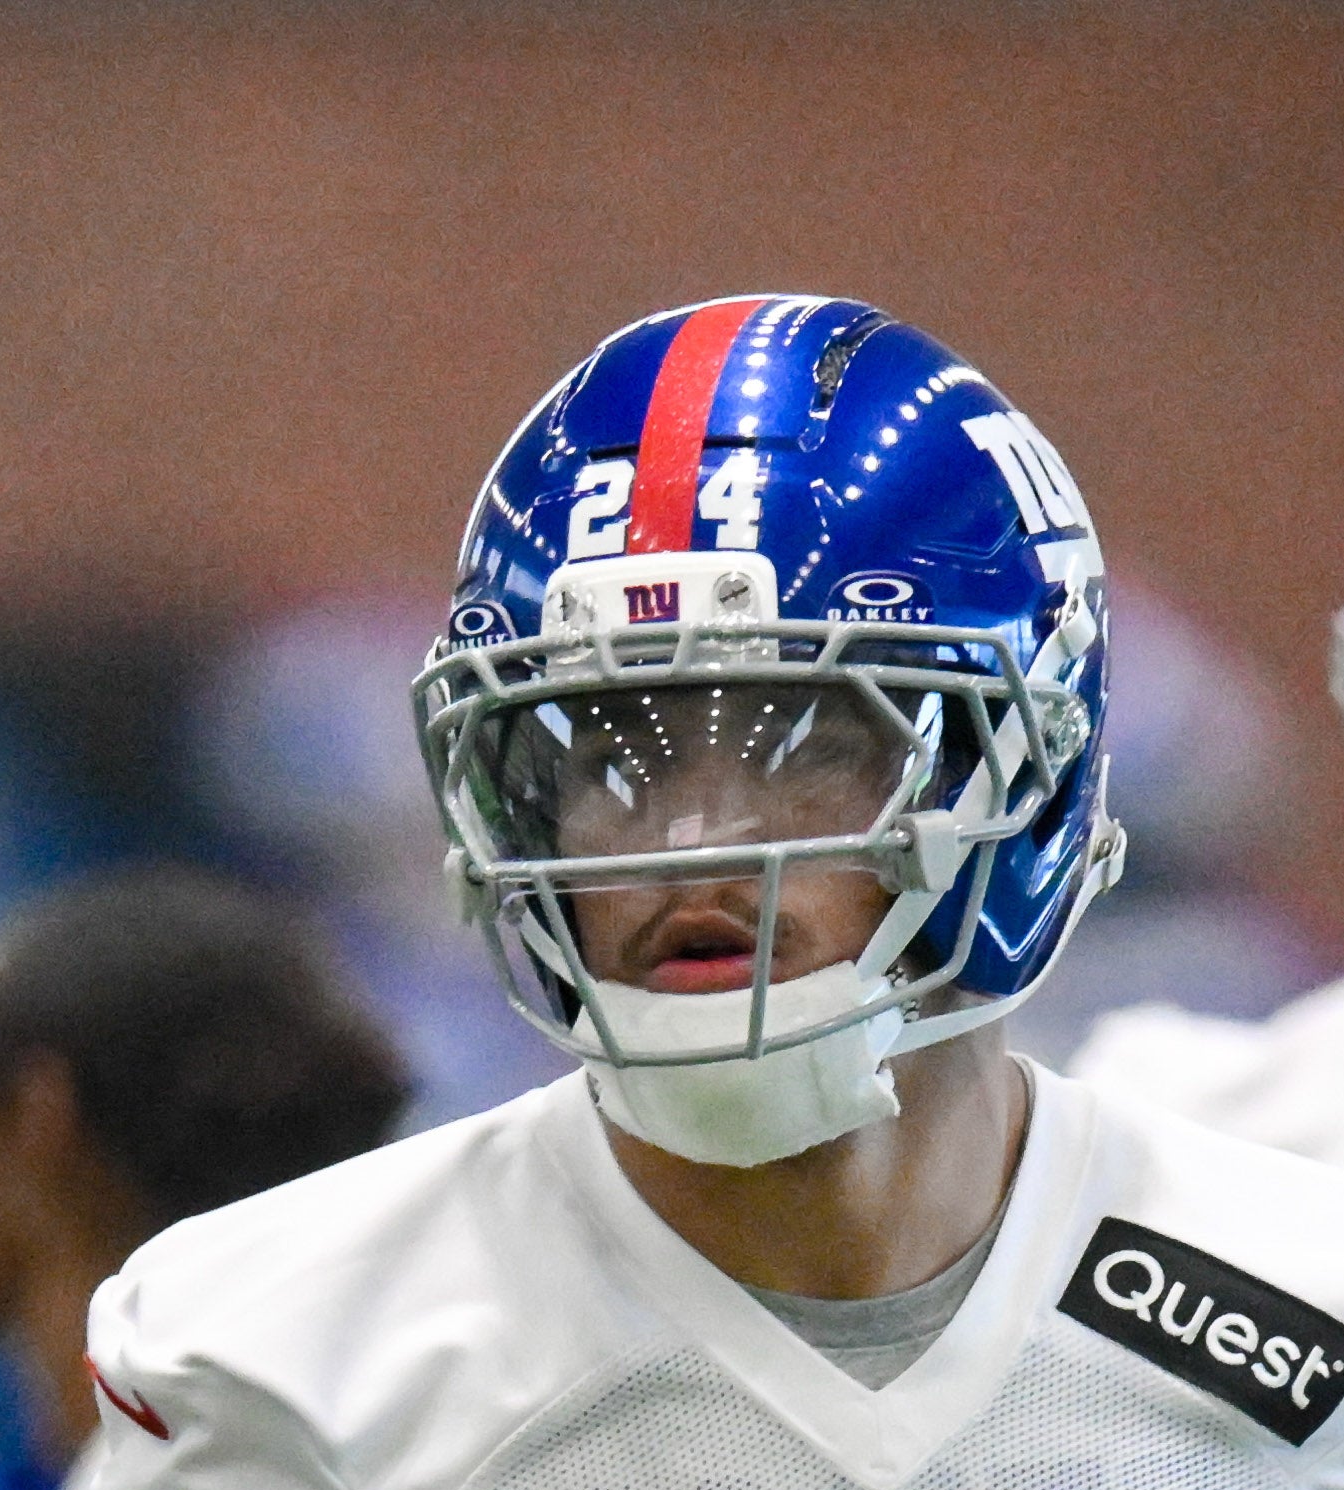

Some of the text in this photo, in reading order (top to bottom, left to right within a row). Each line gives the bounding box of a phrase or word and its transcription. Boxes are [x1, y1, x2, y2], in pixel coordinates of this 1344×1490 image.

[624, 582, 680, 624] ny
[827, 607, 930, 621] OAKLEY
[1093, 1249, 1331, 1411] Quest
